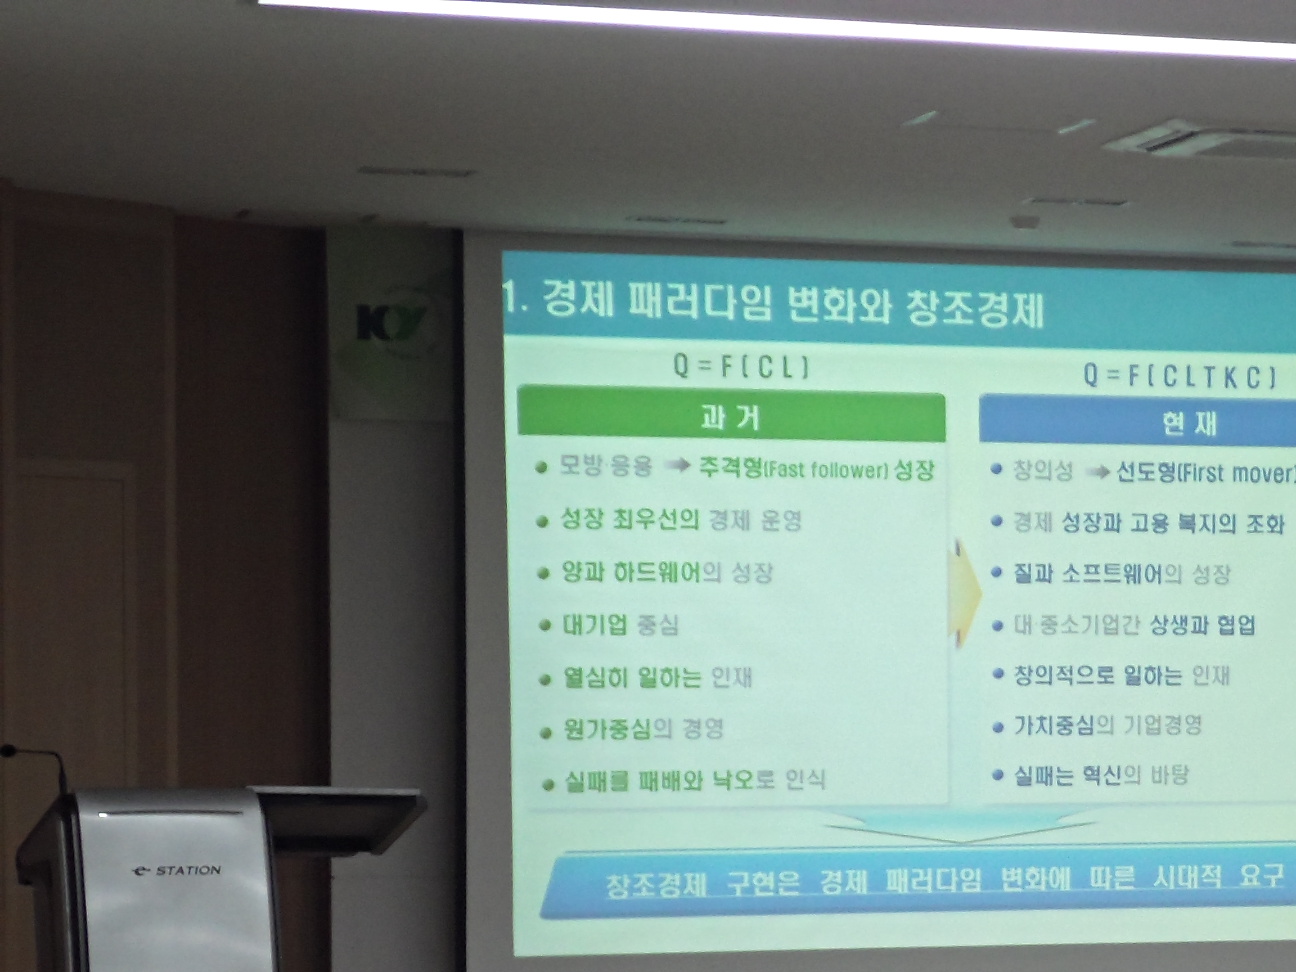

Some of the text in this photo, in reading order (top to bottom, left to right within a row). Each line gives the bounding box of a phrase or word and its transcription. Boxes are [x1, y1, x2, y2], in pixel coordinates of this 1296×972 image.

[502, 279, 1044, 329] 1. 경제 패러다임 변화와 창조경제
[700, 456, 805, 479] 추격형(Fast
[811, 461, 889, 479] follower)
[894, 459, 935, 482] 성장
[1013, 458, 1074, 483] 창의성
[1117, 460, 1224, 484] 선도형(First
[561, 507, 801, 532] 성장 최우선의 경제 운영
[1014, 511, 1285, 535] 경제 성장과 고용 복지의 조화
[562, 560, 774, 584] 양과 하드웨어의 성장
[1014, 563, 1231, 586] 질과 소프트웨어의 성장
[563, 613, 679, 637] 대기업 중심
[1150, 614, 1209, 636] 상생과
[1217, 614, 1256, 636] 협업
[564, 666, 753, 689] 열심히 일하는 인재
[1014, 665, 1231, 687] 창의적으로 일하는 인재
[564, 717, 724, 741] 원가중심의 경영
[1014, 714, 1203, 736] 가치중심의 기업경영
[565, 768, 827, 793] 실패를 패배와 낙오로 인식
[1014, 764, 1190, 787] 실패는 혁신의 바탕
[156, 865, 221, 876] STATION
[606, 863, 1285, 899] 창조경제 구현은 경제 패러다임 변화에 따른 시대적 요구
